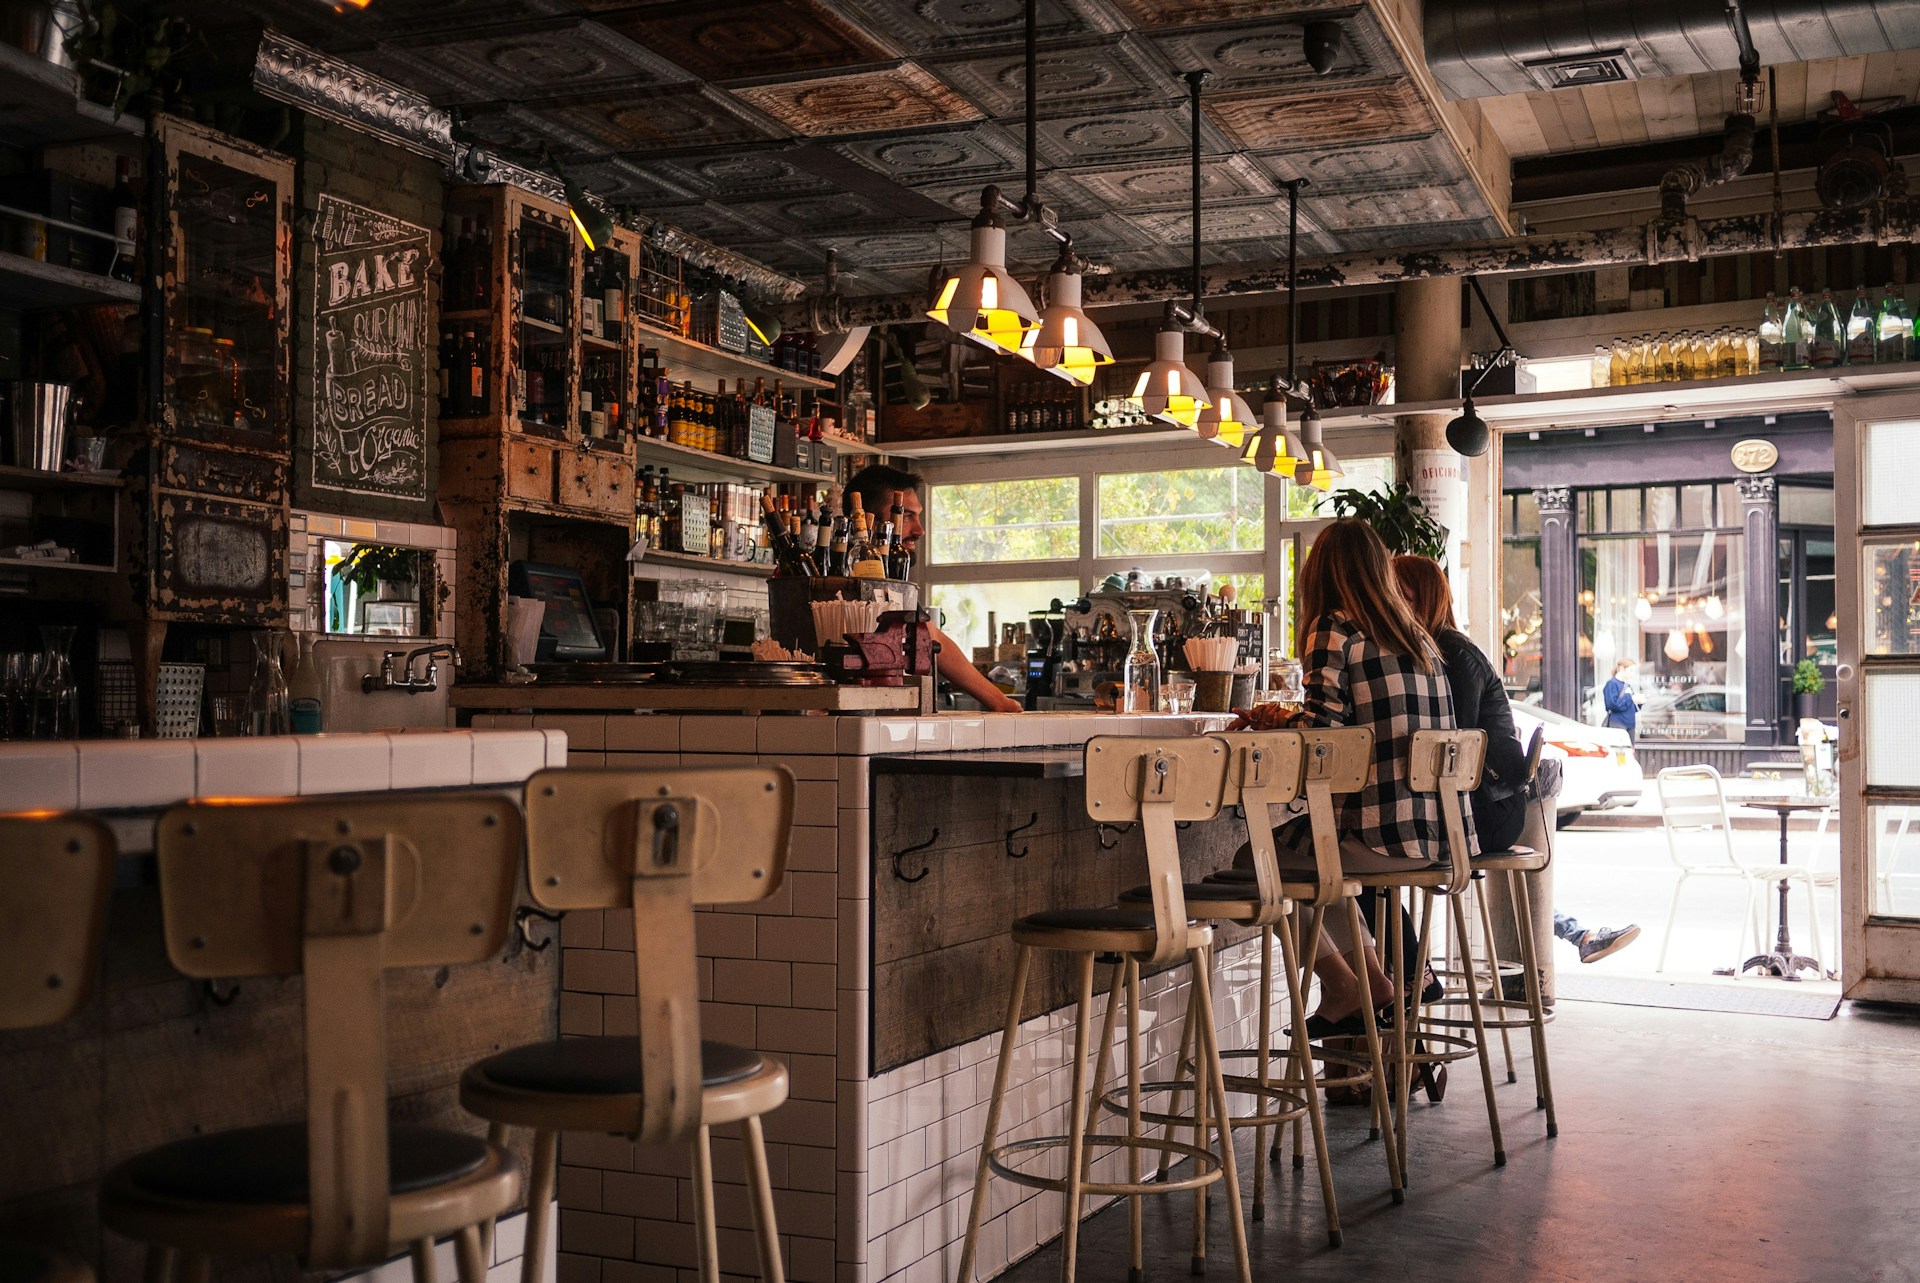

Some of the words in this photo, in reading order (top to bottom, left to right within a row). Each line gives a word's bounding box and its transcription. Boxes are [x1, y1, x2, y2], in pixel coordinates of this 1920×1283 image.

[322, 205, 372, 251] WE
[328, 249, 420, 307] BAKE
[353, 308, 386, 344] OUR
[388, 298, 422, 351] OWN
[332, 373, 407, 422] BREAD
[360, 421, 420, 471] Organic
